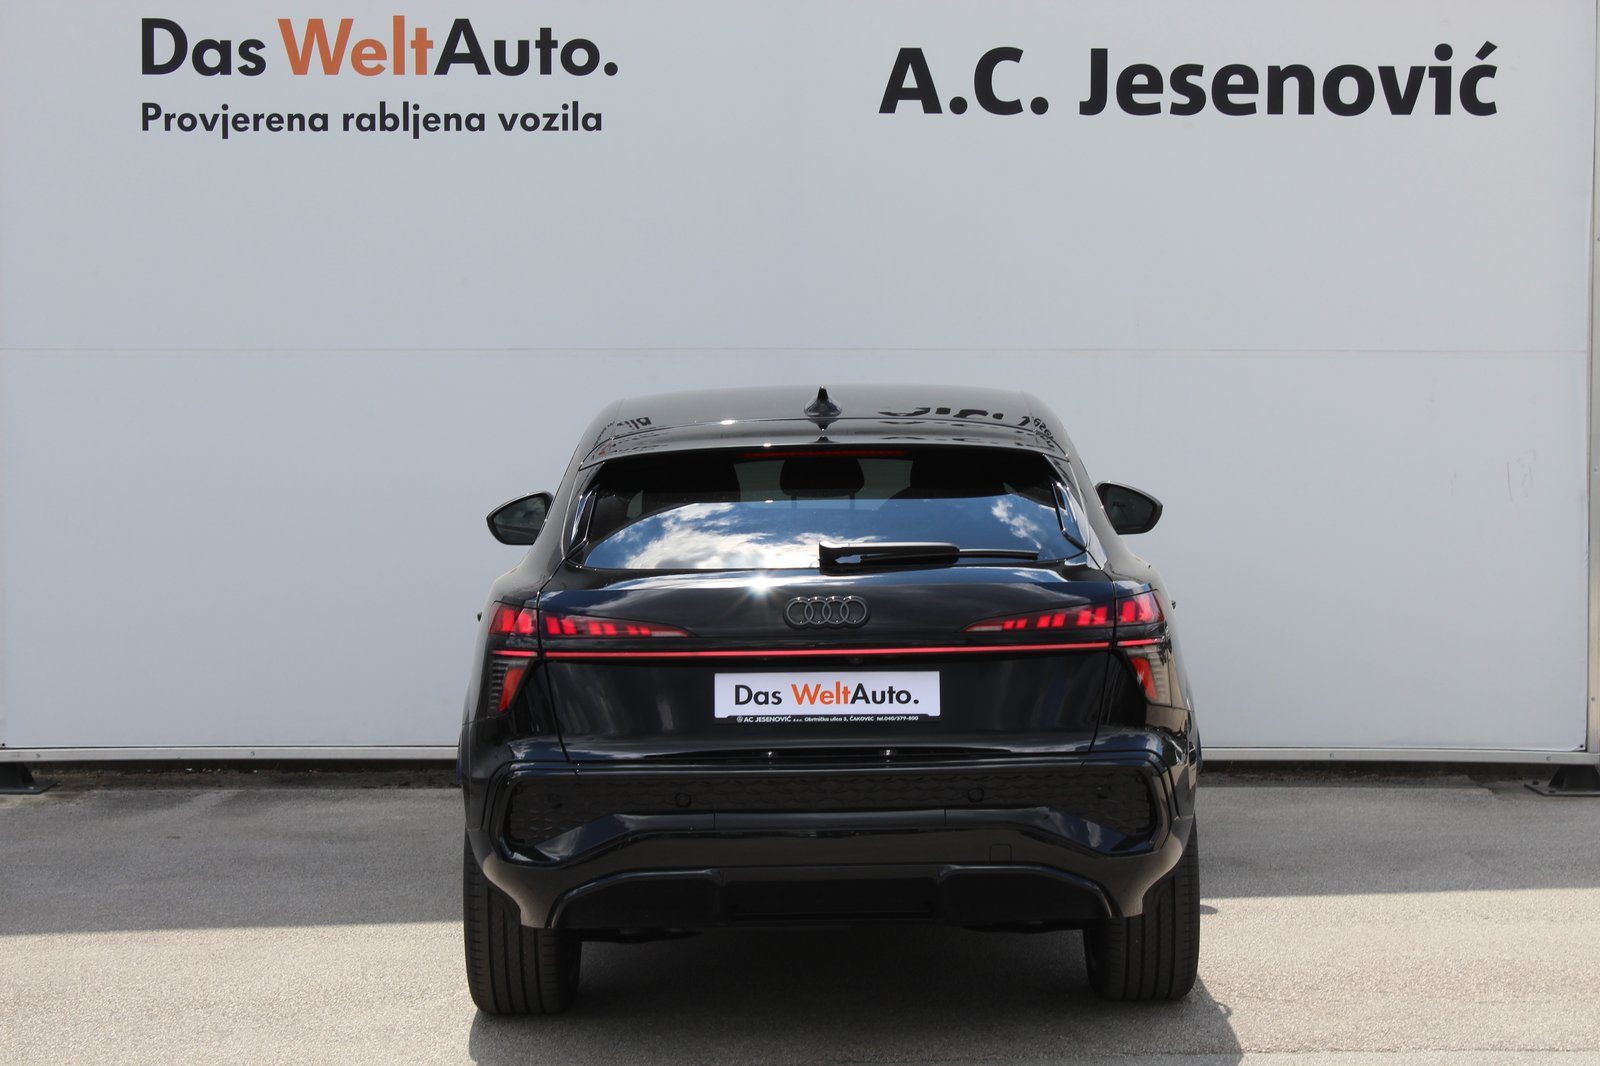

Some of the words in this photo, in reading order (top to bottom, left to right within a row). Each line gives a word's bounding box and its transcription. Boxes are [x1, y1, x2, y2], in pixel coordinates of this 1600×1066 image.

[142, 18, 266, 76] Das
[278, 16, 618, 76] WeltAuto.
[879, 46, 1048, 116] A.C.
[1079, 41, 1498, 116] Jesenović
[142, 102, 329, 140] Provjerena
[343, 101, 486, 140] rabljena
[498, 101, 602, 133] vozila
[734, 684, 783, 706] Das
[792, 681, 920, 705] WeltAuto.
[755, 715, 792, 723] JESENOVIĆ
